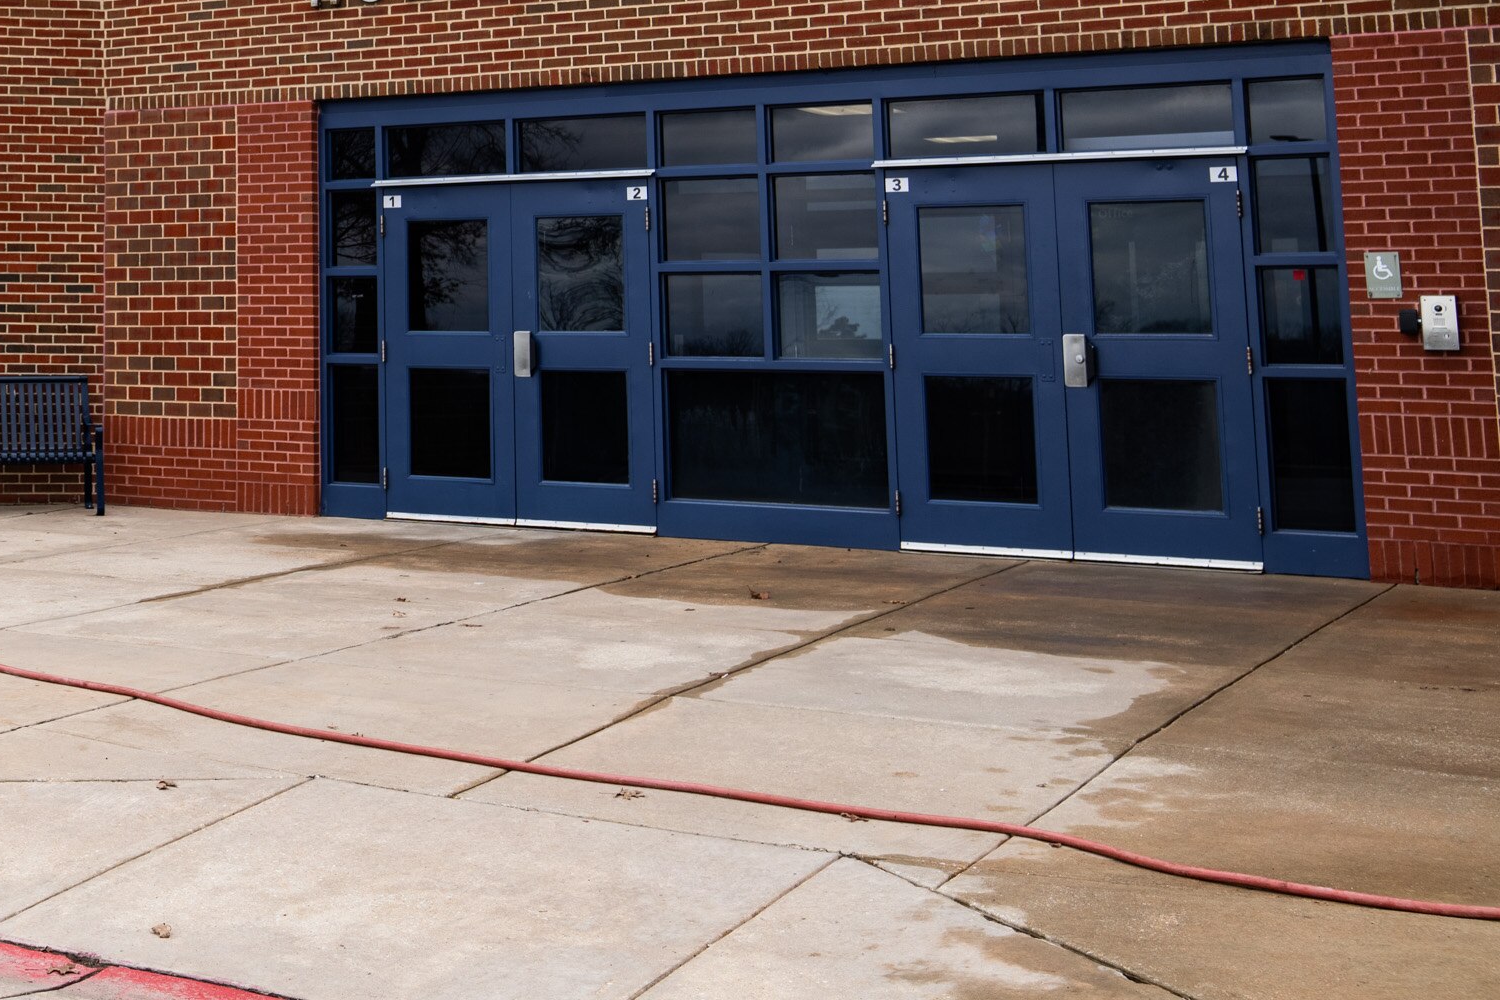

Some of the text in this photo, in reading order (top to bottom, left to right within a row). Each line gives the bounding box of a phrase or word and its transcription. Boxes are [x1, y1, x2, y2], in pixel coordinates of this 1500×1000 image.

[1217, 167, 1229, 181] 4
[892, 178, 901, 191] 3
[633, 187, 641, 199] 2
[389, 196, 395, 207] 1
